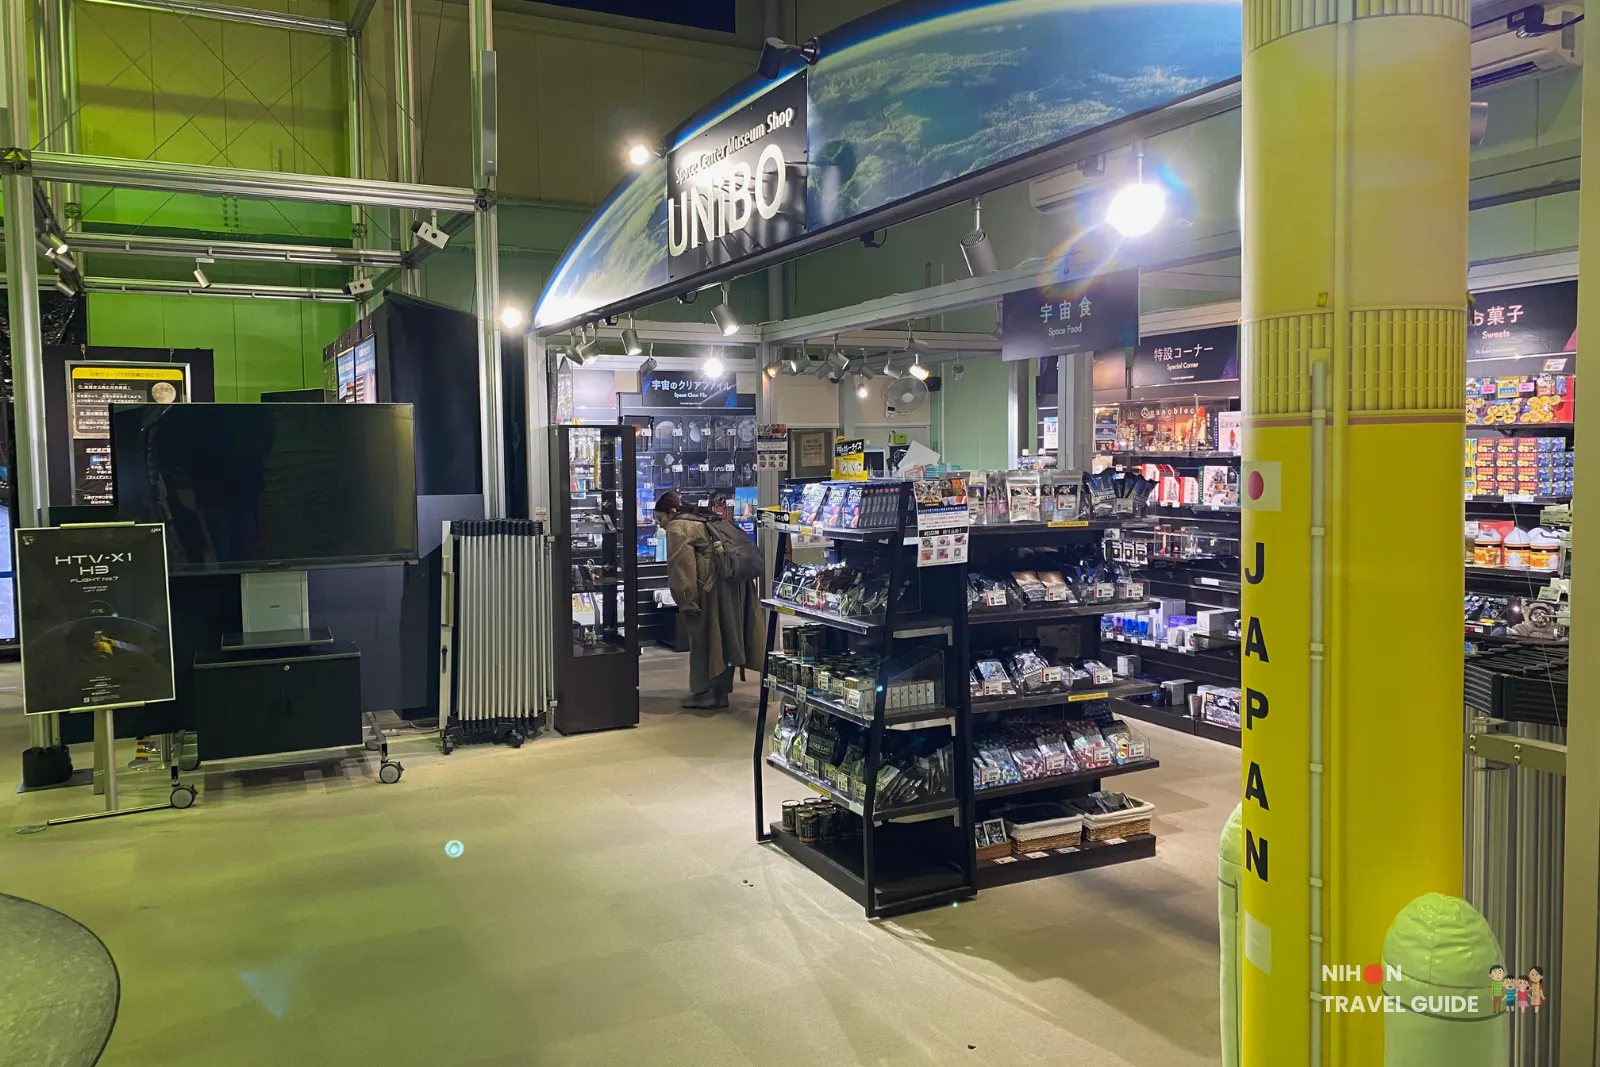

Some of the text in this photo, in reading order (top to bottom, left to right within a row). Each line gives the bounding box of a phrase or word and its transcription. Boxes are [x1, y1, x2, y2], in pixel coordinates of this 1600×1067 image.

[675, 106, 794, 186] Space Center Museum Shop
[1040, 296, 1092, 323] 宇宙食
[1469, 304, 1524, 327] お菓子
[1048, 322, 1083, 338] Space Food
[1481, 329, 1511, 340] Sweets
[1153, 343, 1214, 361] 特設コーナー
[1166, 361, 1200, 371] Special Corner
[651, 380, 732, 391] 宇宙のクリアファイル
[1150, 406, 1195, 417] nanobloc
[55, 552, 132, 565] HTV-X1
[79, 565, 109, 575] H3
[1245, 542, 1270, 883] JAPAN
